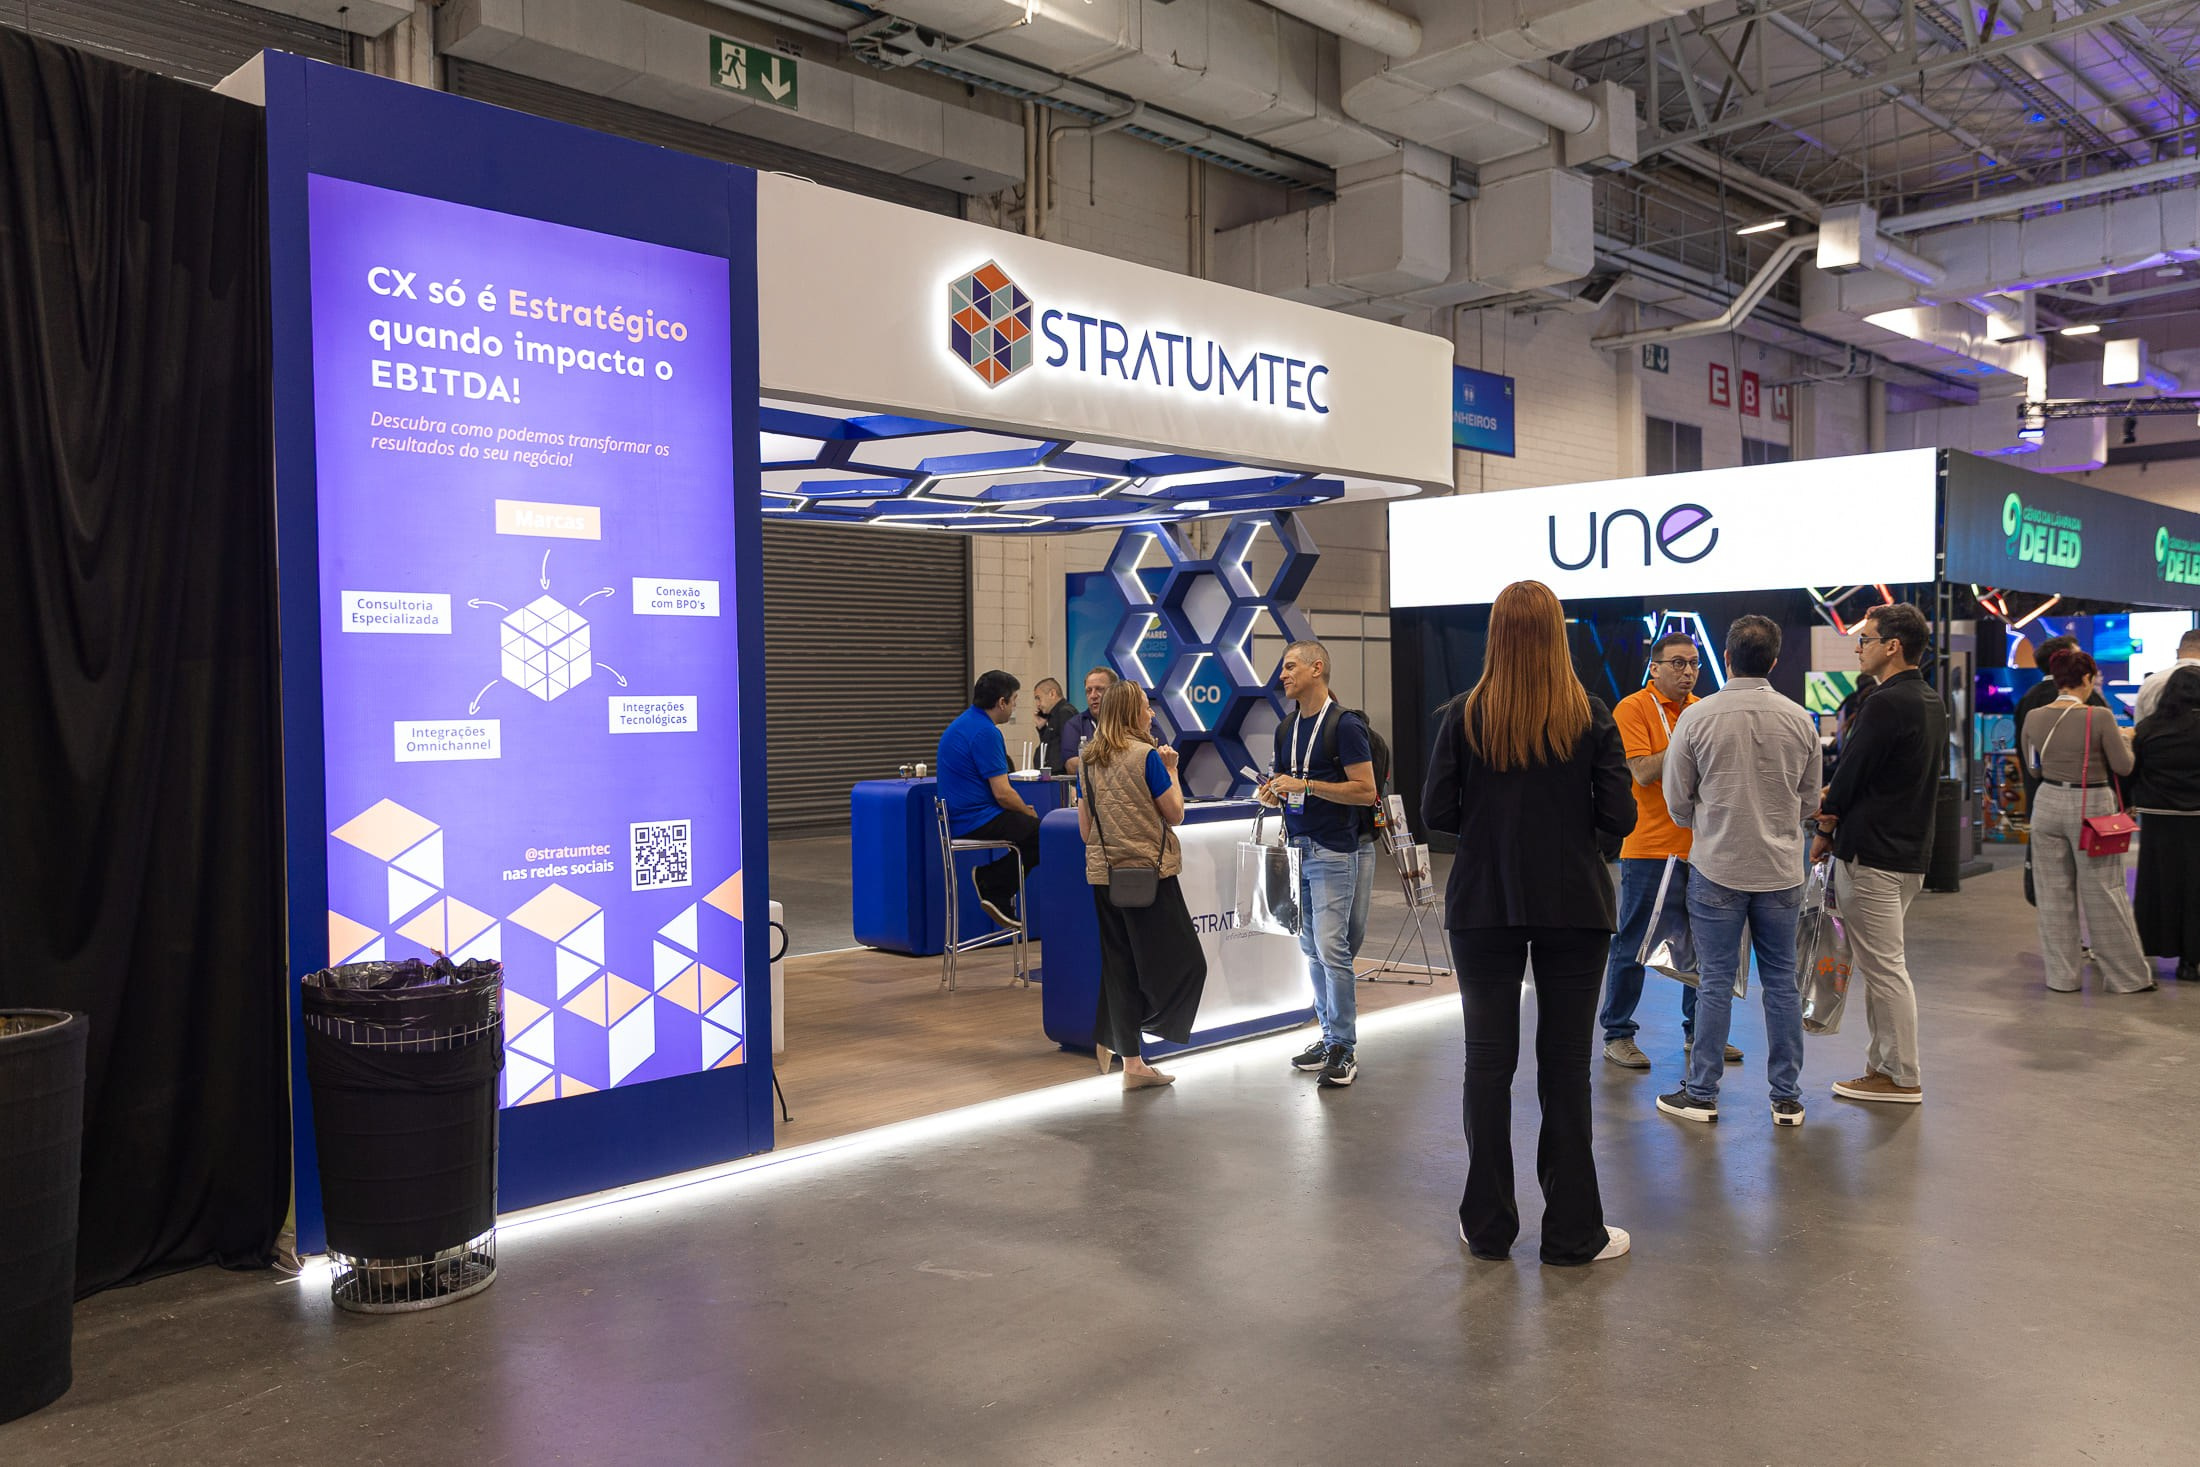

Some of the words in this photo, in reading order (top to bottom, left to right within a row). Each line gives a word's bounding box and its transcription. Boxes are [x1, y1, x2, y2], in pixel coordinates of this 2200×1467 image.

[367, 266, 418, 300] CX
[428, 279, 466, 307] só
[477, 284, 497, 312] é
[508, 289, 688, 343] Estratégico
[368, 318, 503, 357] quando
[514, 331, 646, 377] impacta
[655, 358, 674, 381] o
[1041, 309, 1329, 414] STRATUMTEC
[371, 359, 521, 404] EBITDA!
[1712, 368, 1728, 402] E
[1744, 379, 1756, 407] B
[1454, 410, 1497, 431] NHEIROS
[370, 411, 447, 434] Descubra
[450, 421, 493, 439] como
[497, 426, 565, 446] podemos
[568, 433, 652, 456] transformar
[654, 443, 670, 457] os
[371, 434, 455, 457] resultados
[459, 442, 479, 459] do
[483, 447, 509, 461] seu
[513, 447, 574, 468] negócio!
[514, 509, 586, 532] Marcas
[1549, 503, 1719, 571] une
[2019, 522, 2047, 564] DE
[2046, 528, 2082, 569] LED
[2165, 550, 2185, 583] DE
[2184, 552, 2200, 585] LE
[656, 585, 701, 598] Conexão
[357, 598, 433, 611] Consultoria
[651, 599, 674, 610] com
[676, 598, 706, 610] BPO's
[351, 612, 439, 626] Especializada
[1186, 685, 1221, 703] ICO
[622, 701, 685, 714] Integrações
[620, 713, 688, 727] Tecnológicas
[411, 726, 486, 740] Integrações
[406, 739, 491, 752] Omnichannel
[525, 844, 610, 861] @stratumtec
[503, 867, 527, 881] nas
[530, 863, 567, 878] redes
[570, 859, 613, 874] sociais
[1191, 910, 1235, 933] STRAT
